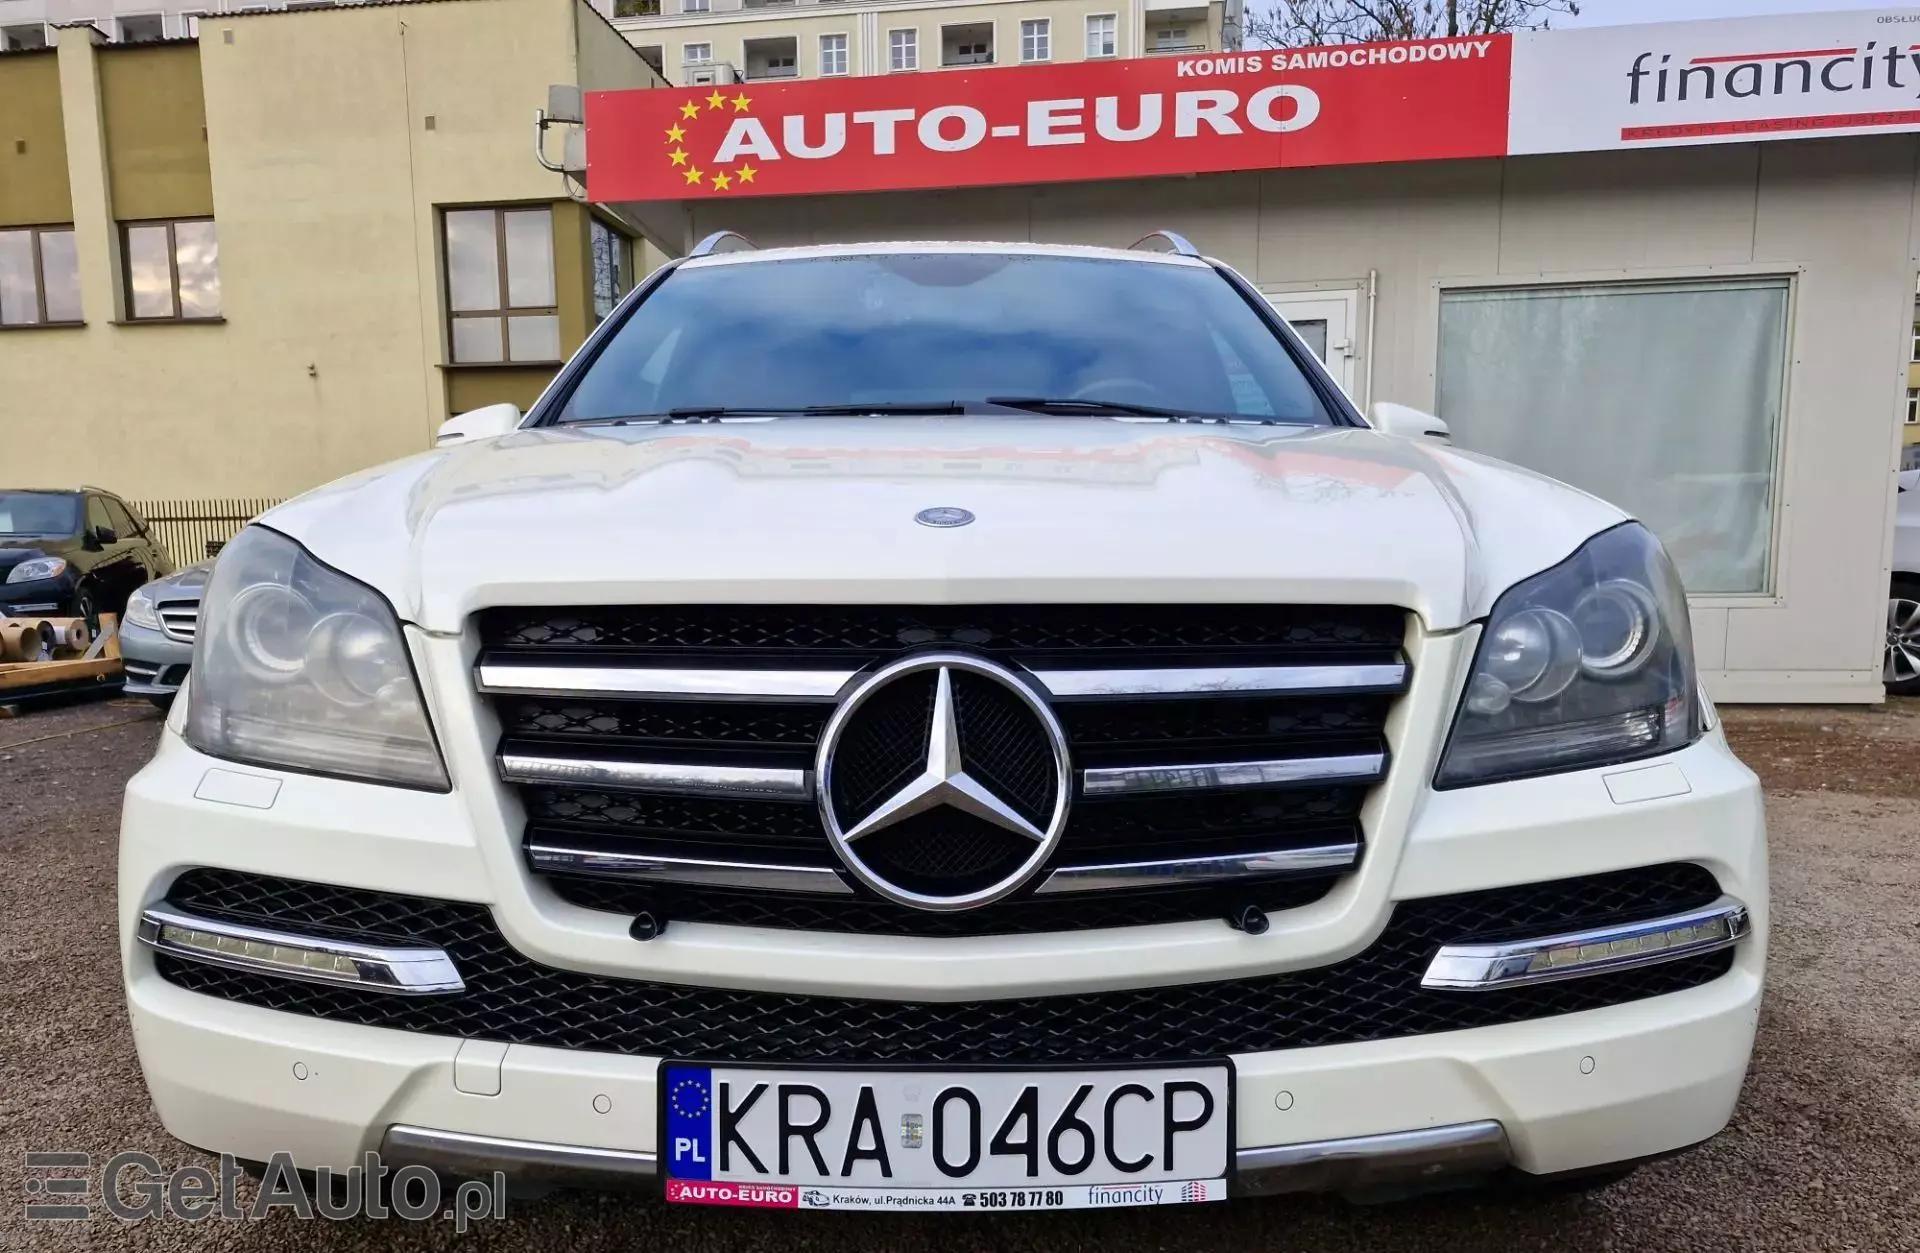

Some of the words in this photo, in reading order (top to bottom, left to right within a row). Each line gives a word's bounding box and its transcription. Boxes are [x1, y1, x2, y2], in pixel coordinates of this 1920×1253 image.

[1177, 55, 1263, 77] KOMIS
[1271, 40, 1492, 71] SAMOCHODOWY
[713, 84, 1321, 163] AUTO-EURO
[719, 1081, 893, 1177] KRA
[931, 1081, 1215, 1178] 046CP
[675, 1138, 706, 1163] PL
[680, 1186, 793, 1203] AUTO-EURO
[833, 1194, 872, 1206] Kraków,
[937, 1196, 956, 1205] 44A
[980, 1192, 1007, 1207] 503
[1010, 1192, 1026, 1207] 78
[1029, 1192, 1044, 1206] 77
[1046, 1190, 1064, 1206] 80
[1088, 1184, 1164, 1205] financity
